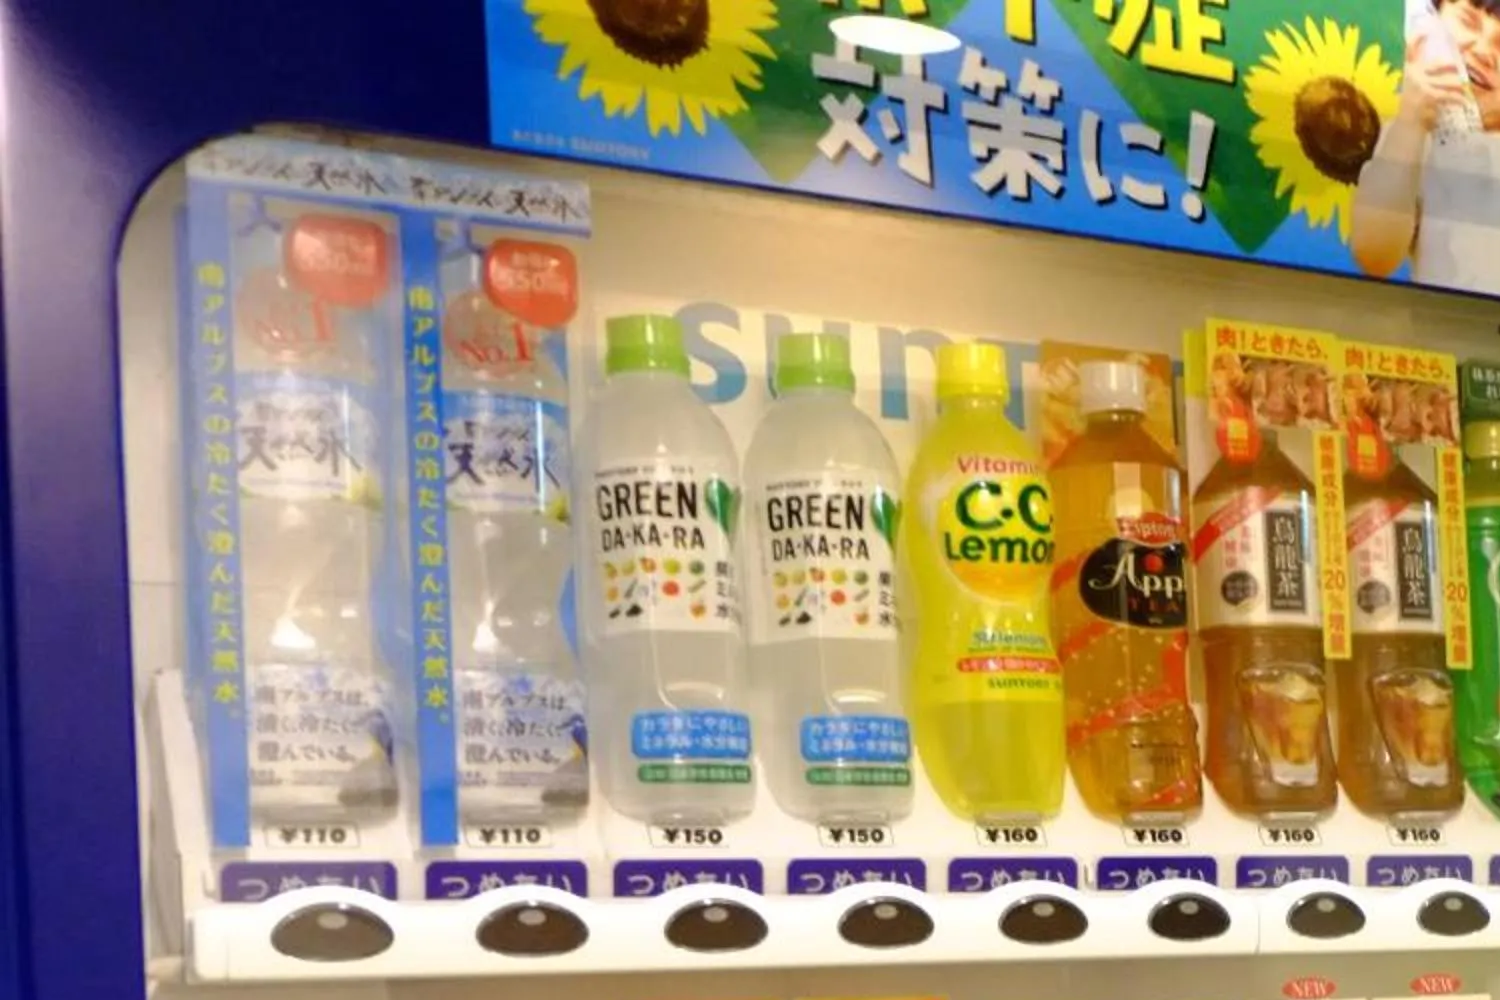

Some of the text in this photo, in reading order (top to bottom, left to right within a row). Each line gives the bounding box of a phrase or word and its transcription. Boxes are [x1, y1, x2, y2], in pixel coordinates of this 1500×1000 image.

[596, 479, 700, 521] GREEN
[766, 494, 866, 533] GREEN
[944, 531, 1055, 565] Lemo
[1271, 515, 1299, 599] 烏龍茶
[1401, 526, 1427, 606] 烏龍茶
[1088, 553, 1187, 599] App
[278, 827, 347, 845] ¥110
[478, 827, 542, 845] ¥110
[661, 828, 724, 845] ¥150
[829, 828, 886, 845] ¥150
[984, 829, 1039, 844] ¥160
[1132, 829, 1184, 844] ¥160
[1267, 829, 1316, 844] ¥160
[1398, 828, 1442, 843] ¥160
[1291, 981, 1328, 998] NEW
[1420, 976, 1454, 993] NEW
